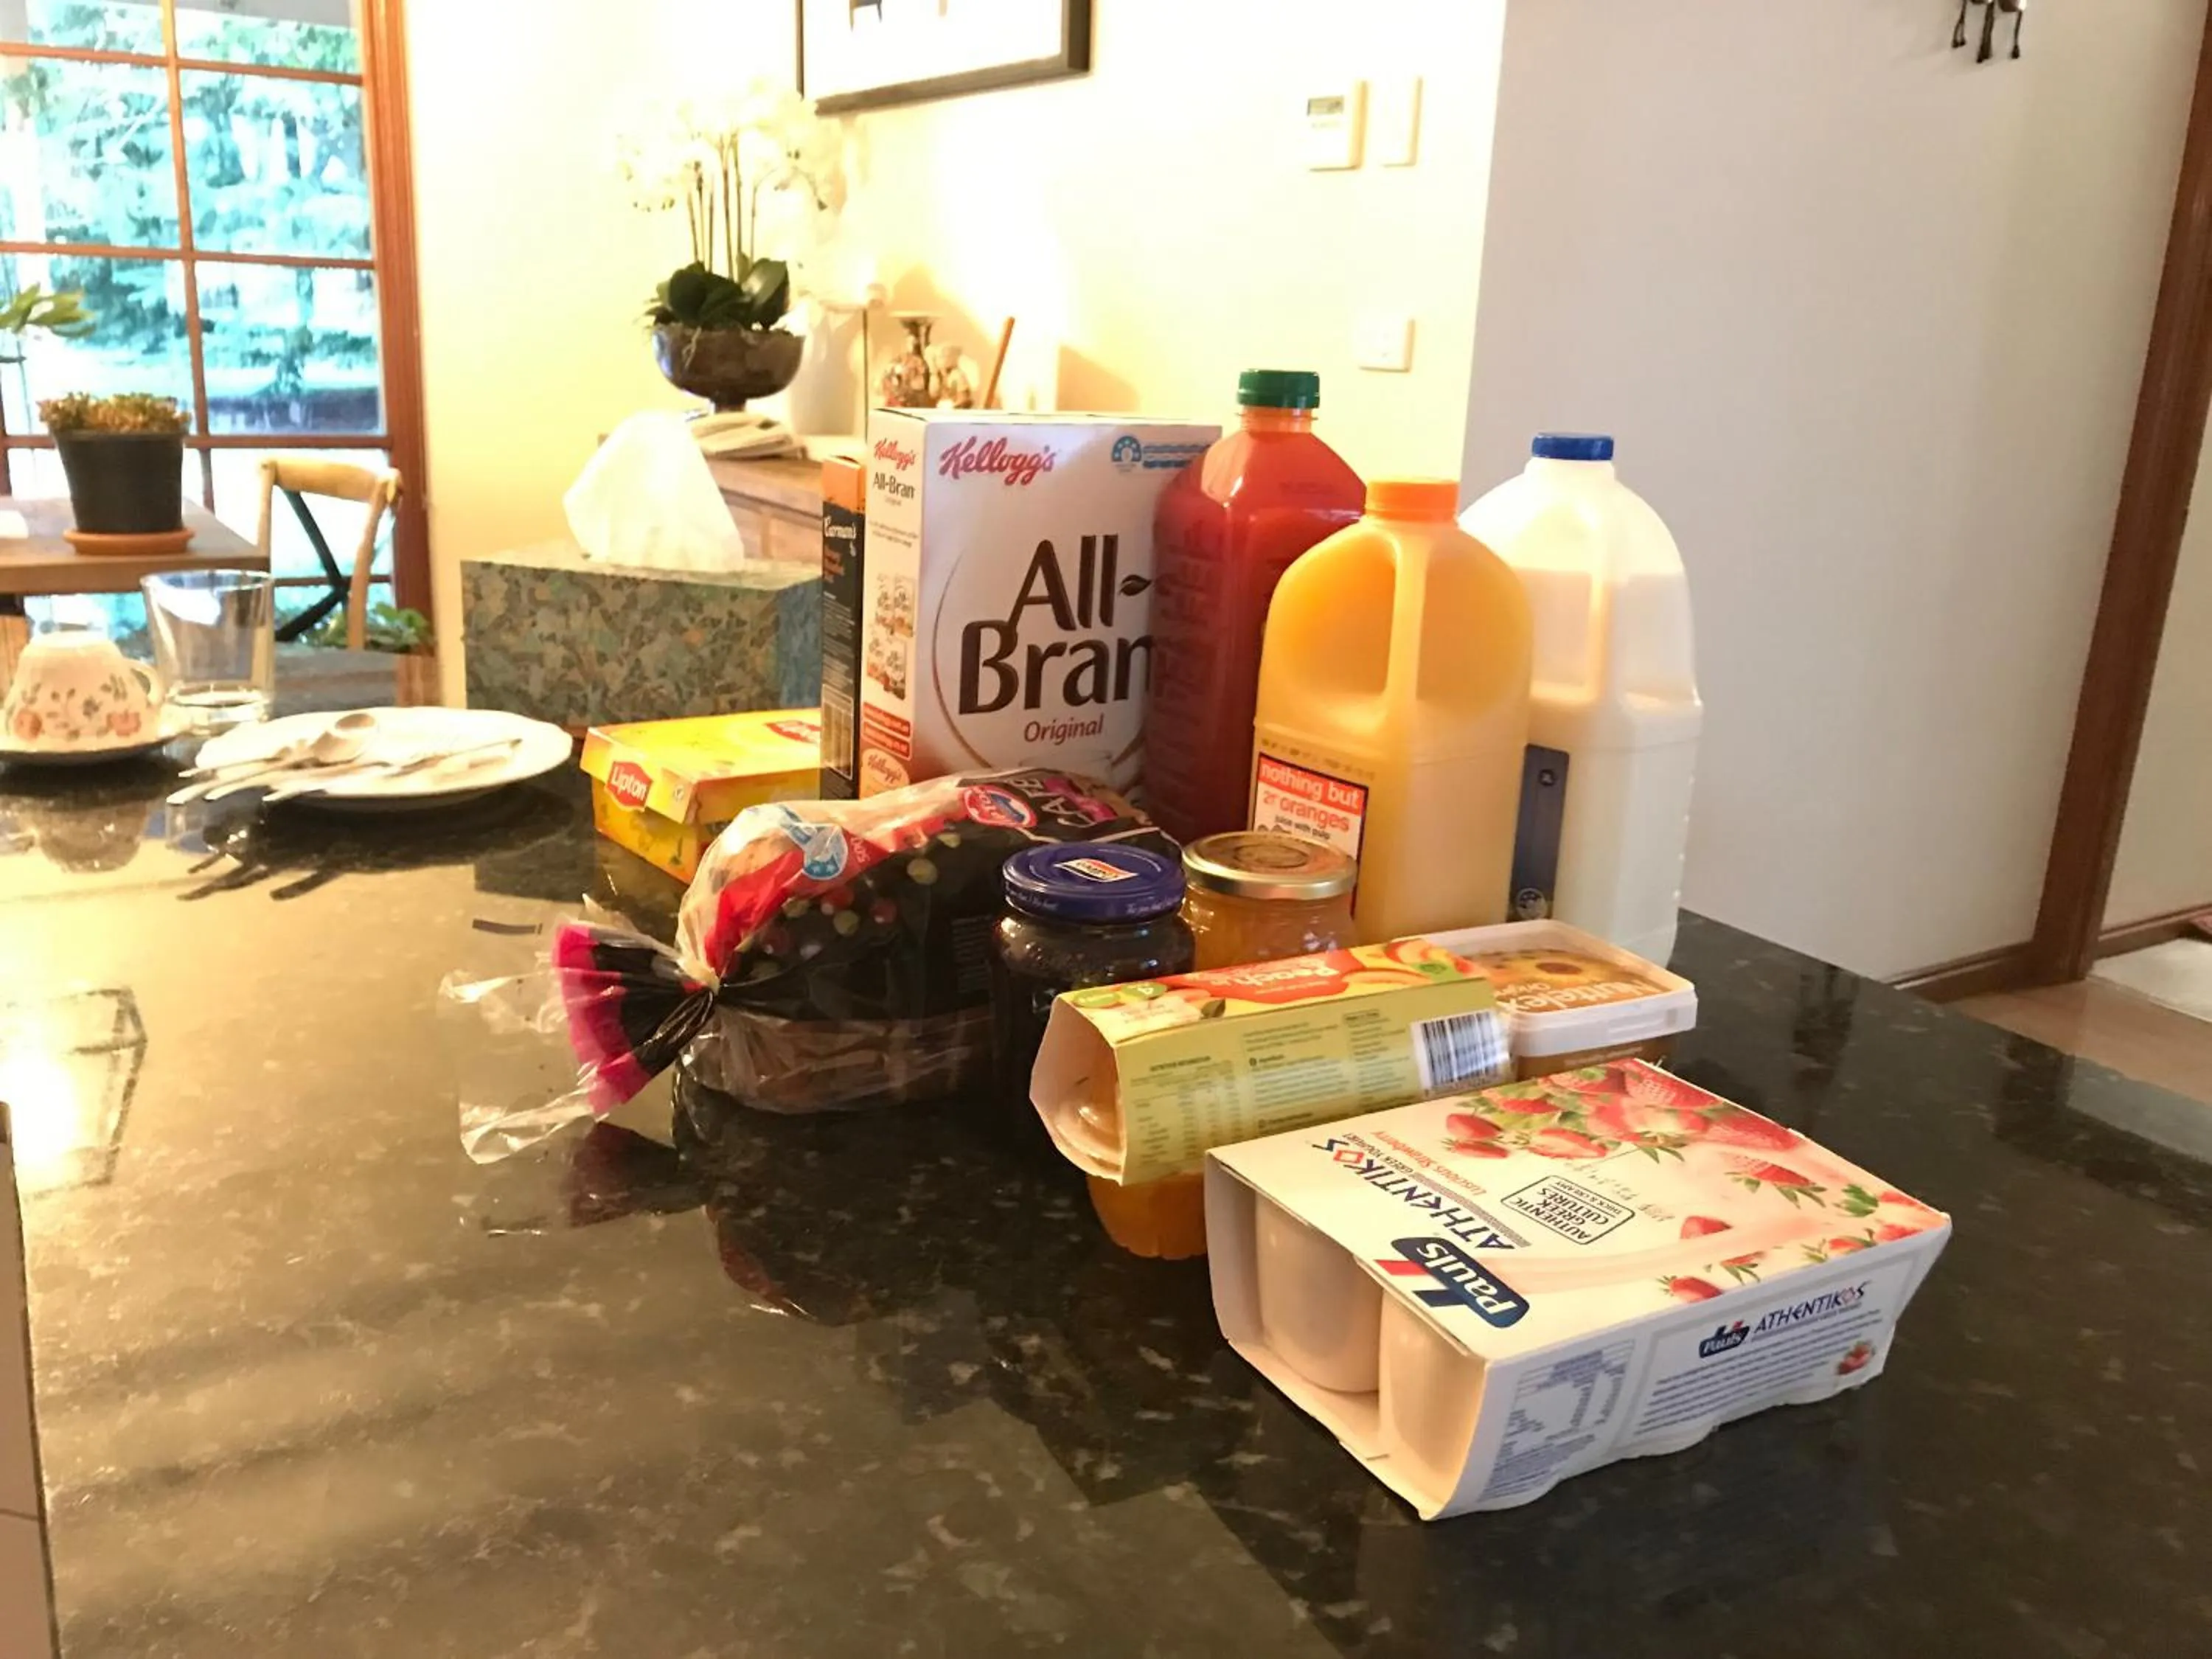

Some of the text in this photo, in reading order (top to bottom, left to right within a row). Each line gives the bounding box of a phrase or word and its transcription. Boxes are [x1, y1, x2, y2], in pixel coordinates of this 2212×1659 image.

[874, 437, 917, 470] Kellogg's
[939, 437, 1057, 486] Kellogg's
[873, 472, 915, 499] All-Bran
[959, 620, 1152, 715] Bran
[1023, 714, 1104, 746] Original
[611, 765, 648, 801] Lipton
[1261, 763, 1359, 809] nothing but
[1279, 796, 1350, 832] oranges
[1234, 966, 1340, 987] Peach
[1495, 978, 1660, 1015] Nuttelex
[1342, 1132, 1413, 1174] GREEK YOGHURT
[1371, 1130, 1486, 1196] Luscious Strawberry
[1312, 1138, 1515, 1250] ATHENTIKOS
[1537, 1186, 1610, 1225] CULTURES
[1554, 1180, 1590, 1197] CREAMY
[1510, 1197, 1593, 1240] AUTHENTIC
[1541, 1198, 1586, 1225] GREEK
[1598, 1201, 1623, 1215] THICK
[1416, 1242, 1518, 1315] Pauls
[1703, 1279, 1874, 1354] Pauls ATHENTIKOS
